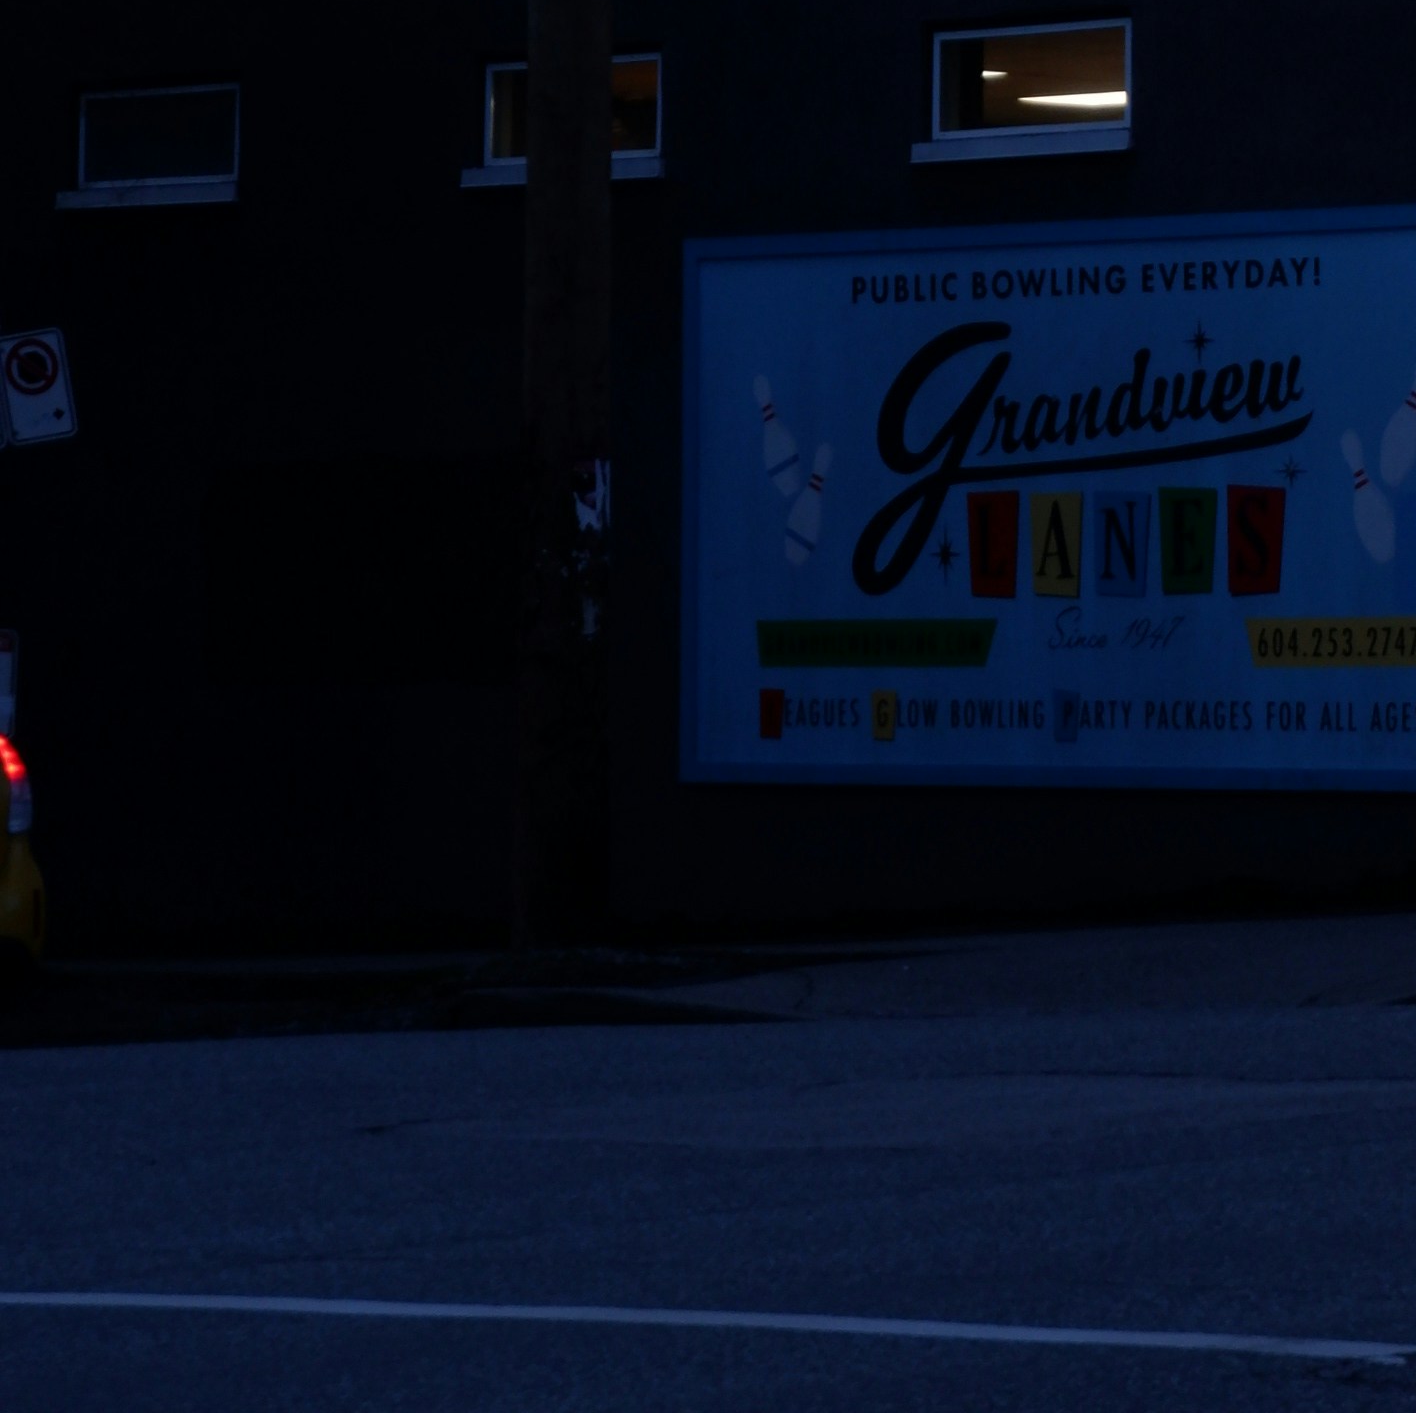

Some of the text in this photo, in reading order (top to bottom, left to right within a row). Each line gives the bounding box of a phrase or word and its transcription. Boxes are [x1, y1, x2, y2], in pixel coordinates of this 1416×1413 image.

[851, 256, 1322, 304] PUBLIC BOWLING EVERYDAY!
[851, 321, 1313, 596] Grandview
[973, 491, 1272, 582] LANES
[1047, 605, 1187, 652] Since 1947
[876, 697, 939, 730] GLOW
[950, 698, 1046, 731] BOWLING
[1063, 698, 1134, 730] PARTY
[1144, 699, 1254, 732] PACKAGES
[1265, 700, 1307, 732] FOR
[1318, 701, 1358, 733] ALL
